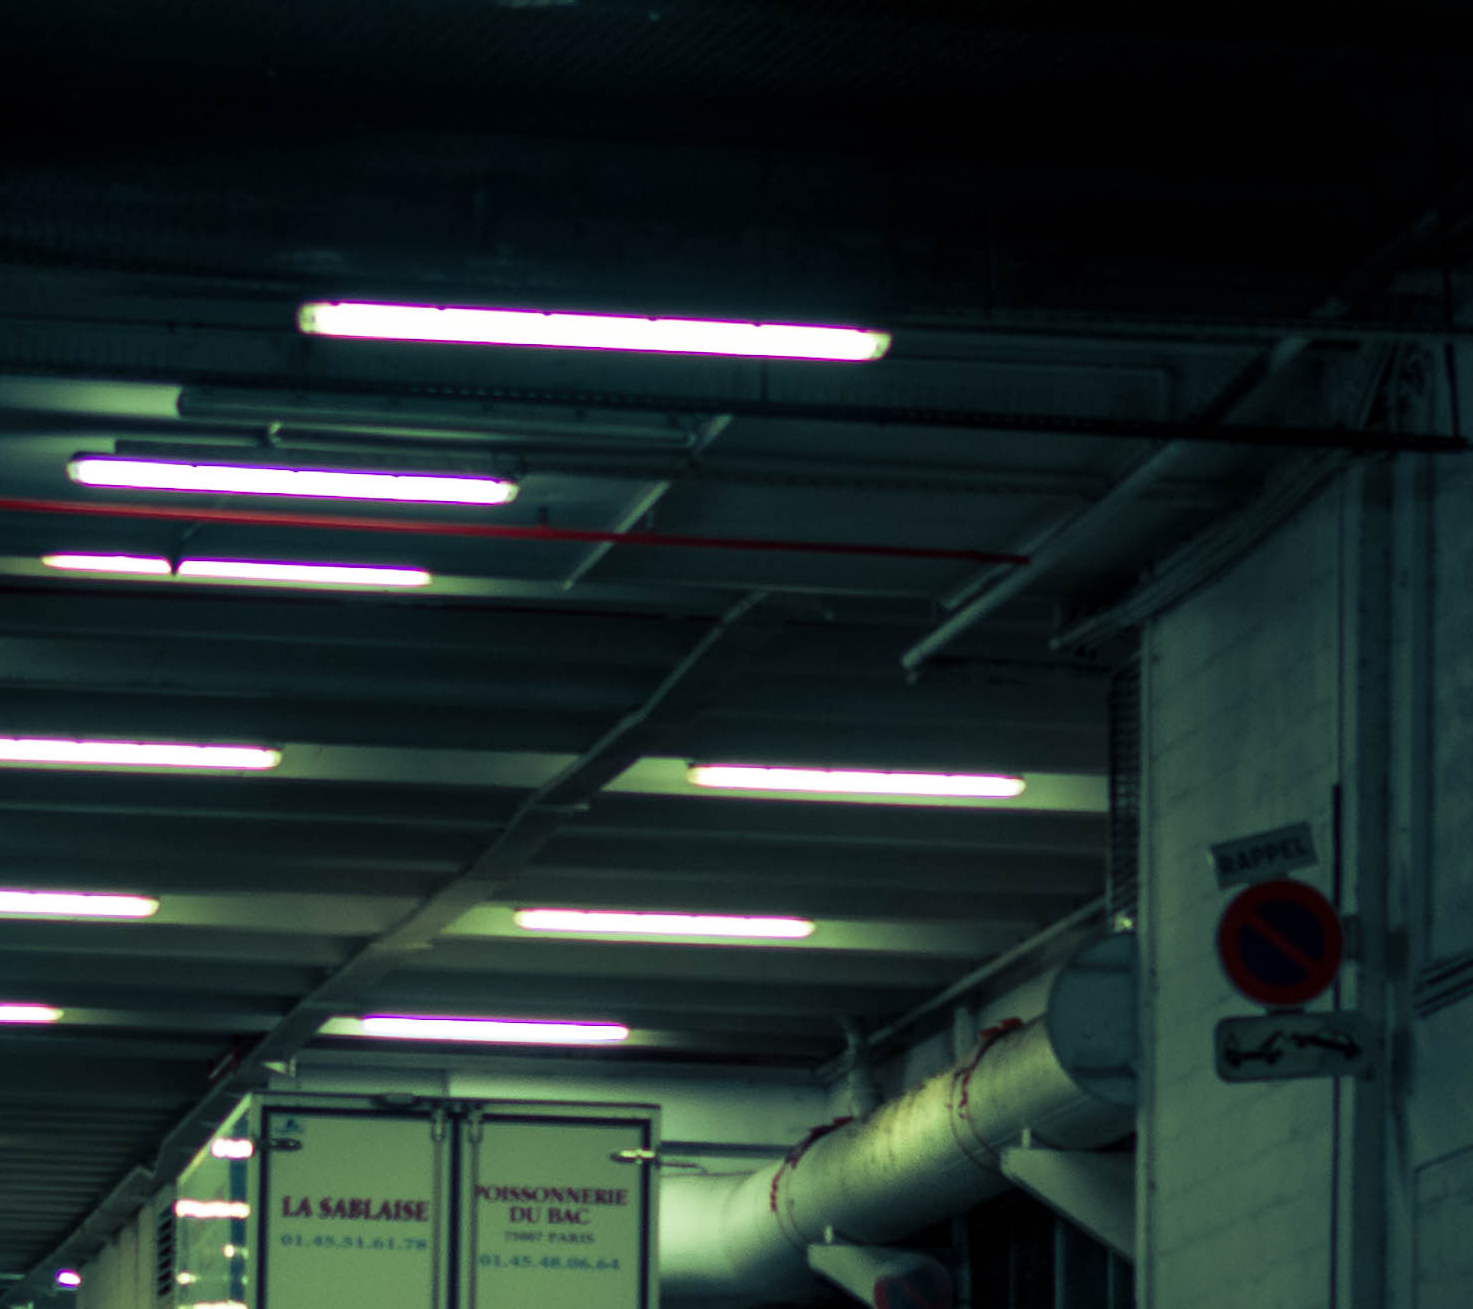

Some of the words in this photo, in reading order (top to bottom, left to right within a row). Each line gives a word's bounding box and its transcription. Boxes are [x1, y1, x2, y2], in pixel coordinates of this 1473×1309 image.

[1219, 837, 1308, 874] RAPPEL
[474, 1184, 628, 1205] POISSONNERIE
[282, 1196, 312, 1217] LA
[319, 1197, 430, 1222] SABLAISE
[509, 1206, 540, 1223] DU
[547, 1207, 591, 1225] BAC
[548, 1233, 595, 1244] PARIS
